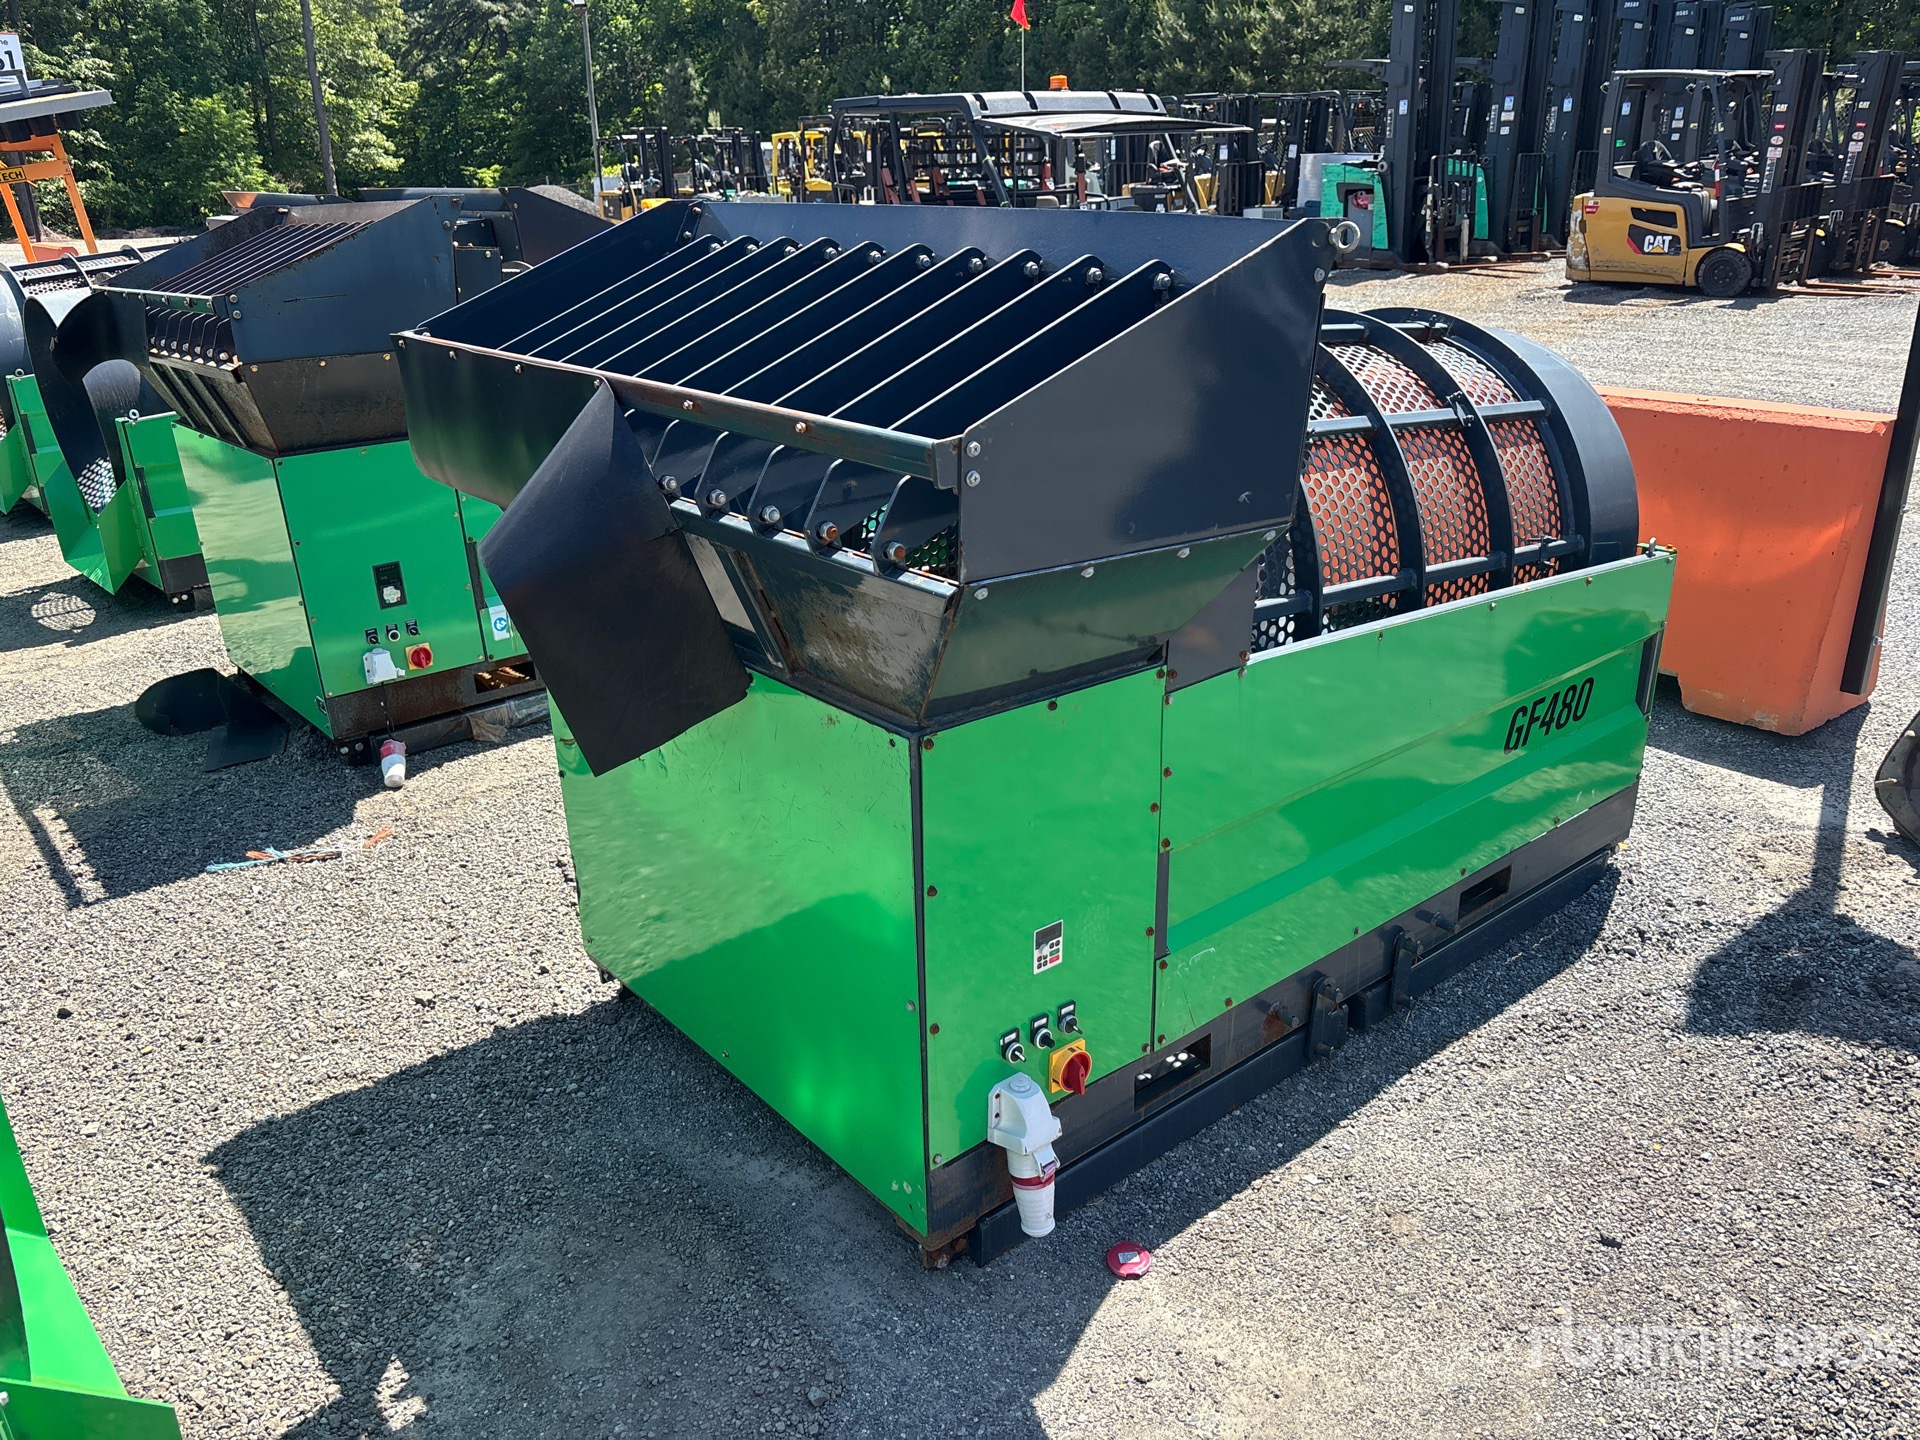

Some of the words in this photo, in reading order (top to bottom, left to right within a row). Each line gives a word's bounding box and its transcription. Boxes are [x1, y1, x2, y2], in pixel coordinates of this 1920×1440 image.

[1775, 103, 1789, 112] CAT
[1643, 235, 1673, 253] CAT
[1503, 676, 1595, 755] GF480
